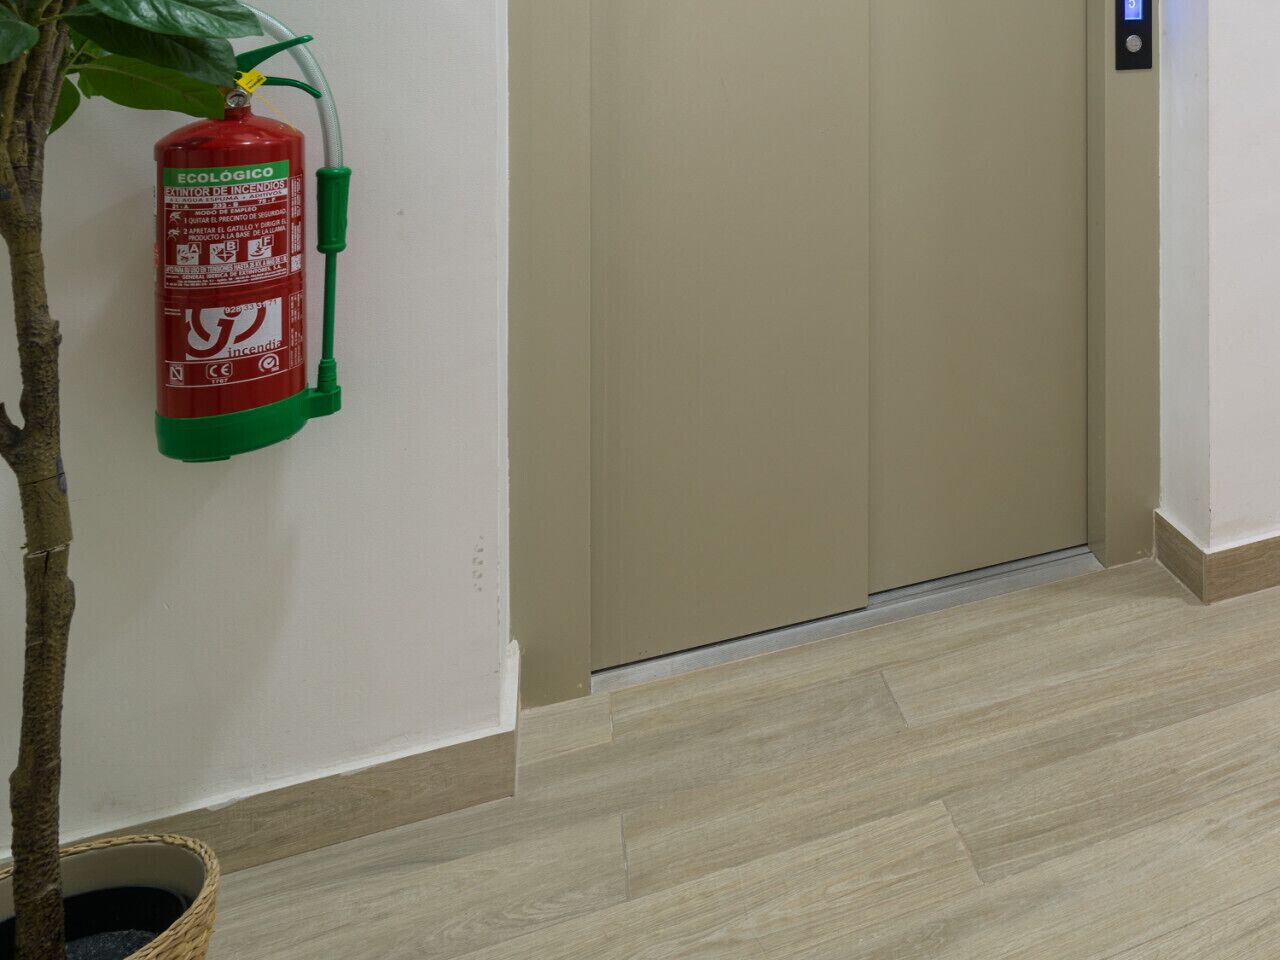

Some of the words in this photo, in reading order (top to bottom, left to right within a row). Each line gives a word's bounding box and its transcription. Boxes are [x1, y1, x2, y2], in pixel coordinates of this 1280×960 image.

[177, 167, 274, 184] ECOLÓGICO
[165, 187, 211, 197] EXTINTOR
[212, 186, 228, 196] DE
[231, 181, 285, 195] INCENDIOS
[231, 206, 257, 214] EMPLEO
[219, 214, 248, 223] PRECINTO
[248, 212, 257, 220] DE
[226, 224, 253, 232] GATILLO
[260, 219, 281, 228] DIRIGIR
[188, 233, 219, 241] PRODUCTO
[235, 230, 250, 238] BASE
[261, 227, 269, 235] LA
[226, 241, 236, 250] B
[263, 237, 271, 246] F
[189, 244, 199, 254] A
[225, 305, 241, 314] 928
[243, 303, 254, 311] 33
[227, 339, 282, 358] incendia
